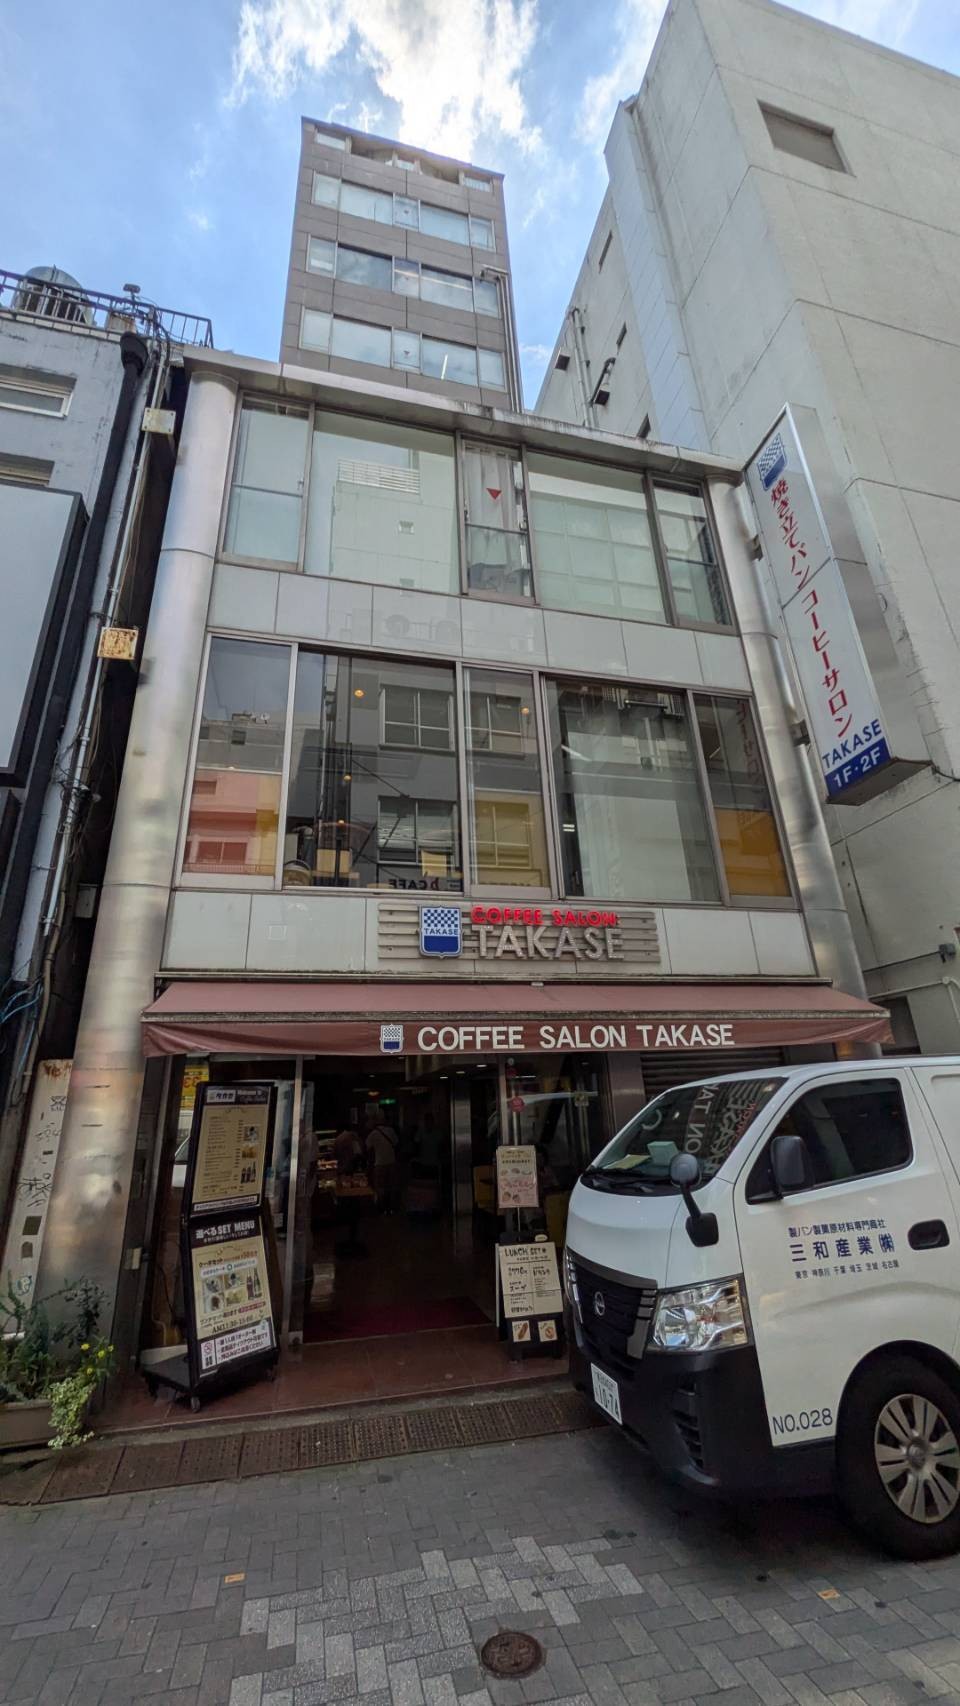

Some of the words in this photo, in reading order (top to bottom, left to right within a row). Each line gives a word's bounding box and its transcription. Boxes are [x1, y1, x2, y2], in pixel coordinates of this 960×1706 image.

[801, 589, 853, 738] コーヒーサロン
[822, 718, 882, 769] TAKASE
[470, 906, 544, 924] COFFEE
[552, 909, 617, 926] SALON
[423, 928, 459, 936] TAKASE
[472, 924, 625, 960] TAKASE
[418, 1026, 524, 1050] COFFEE
[540, 1025, 626, 1049] SALON
[636, 1024, 735, 1047] TAKASE
[772, 1408, 833, 1435] NO.028
